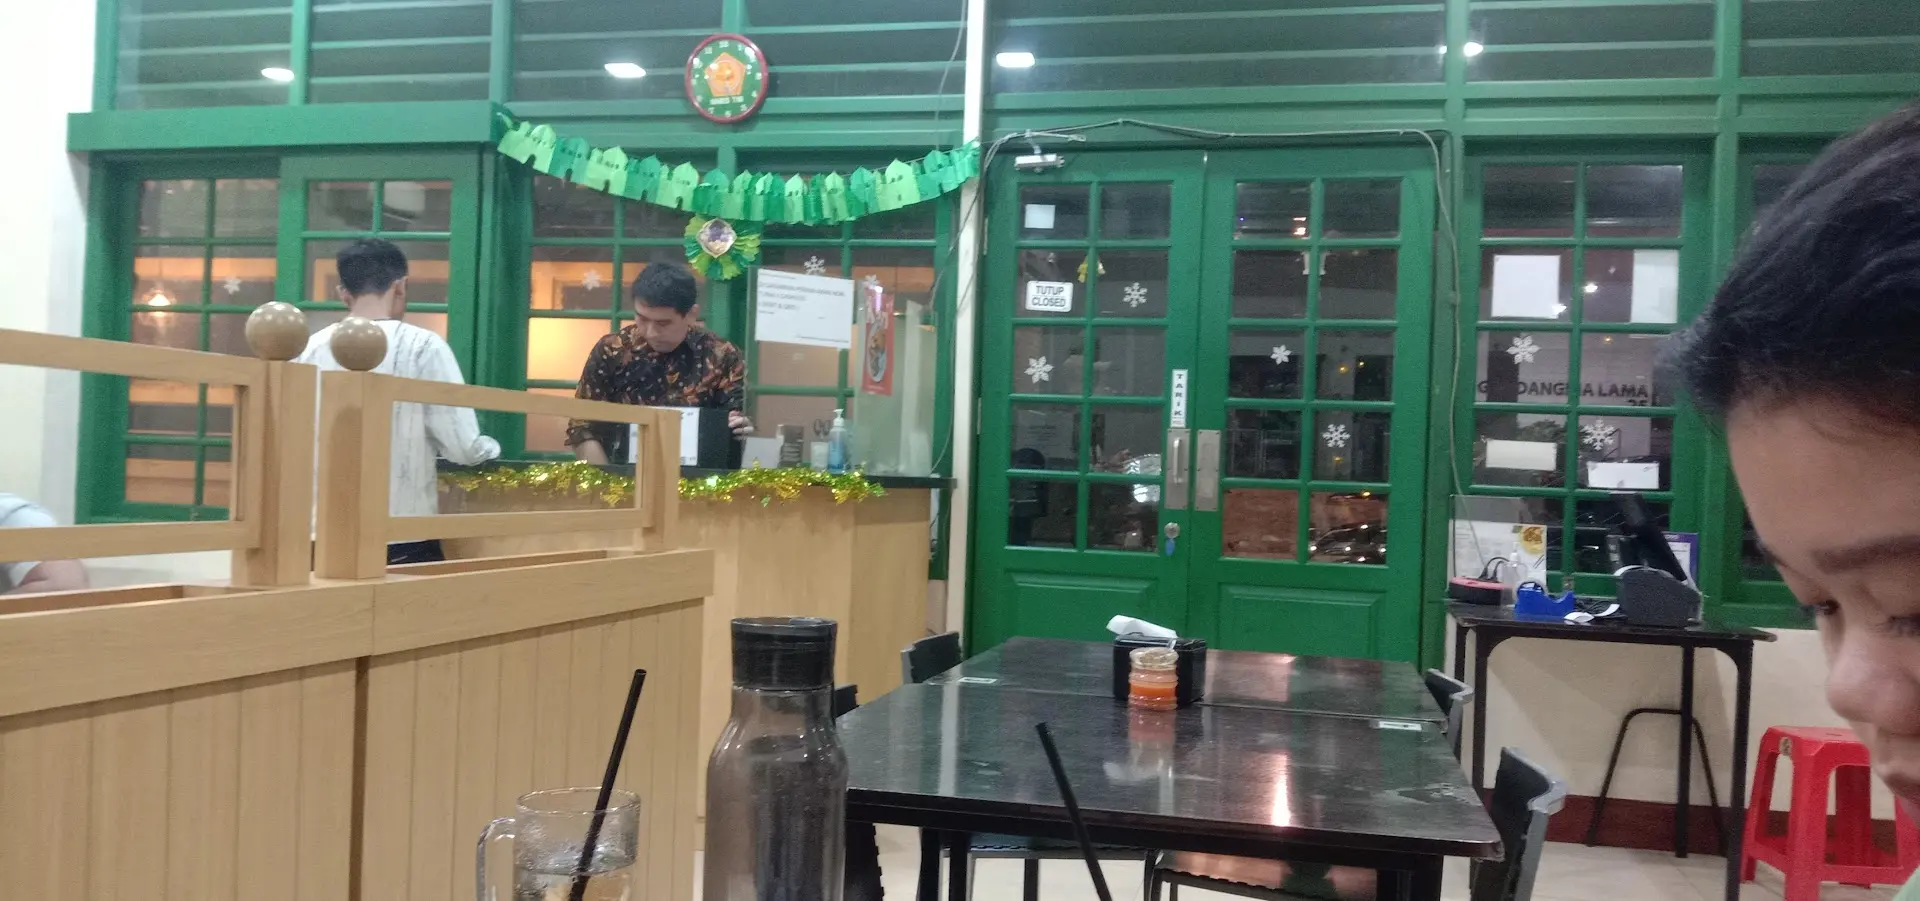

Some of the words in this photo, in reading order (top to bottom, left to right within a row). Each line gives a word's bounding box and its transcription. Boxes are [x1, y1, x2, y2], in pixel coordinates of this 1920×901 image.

[1035, 285, 1065, 296] TUTUP
[1031, 296, 1066, 308] CLOSED
[1174, 373, 1184, 416] TARIK
[1598, 382, 1648, 398] LAMA
